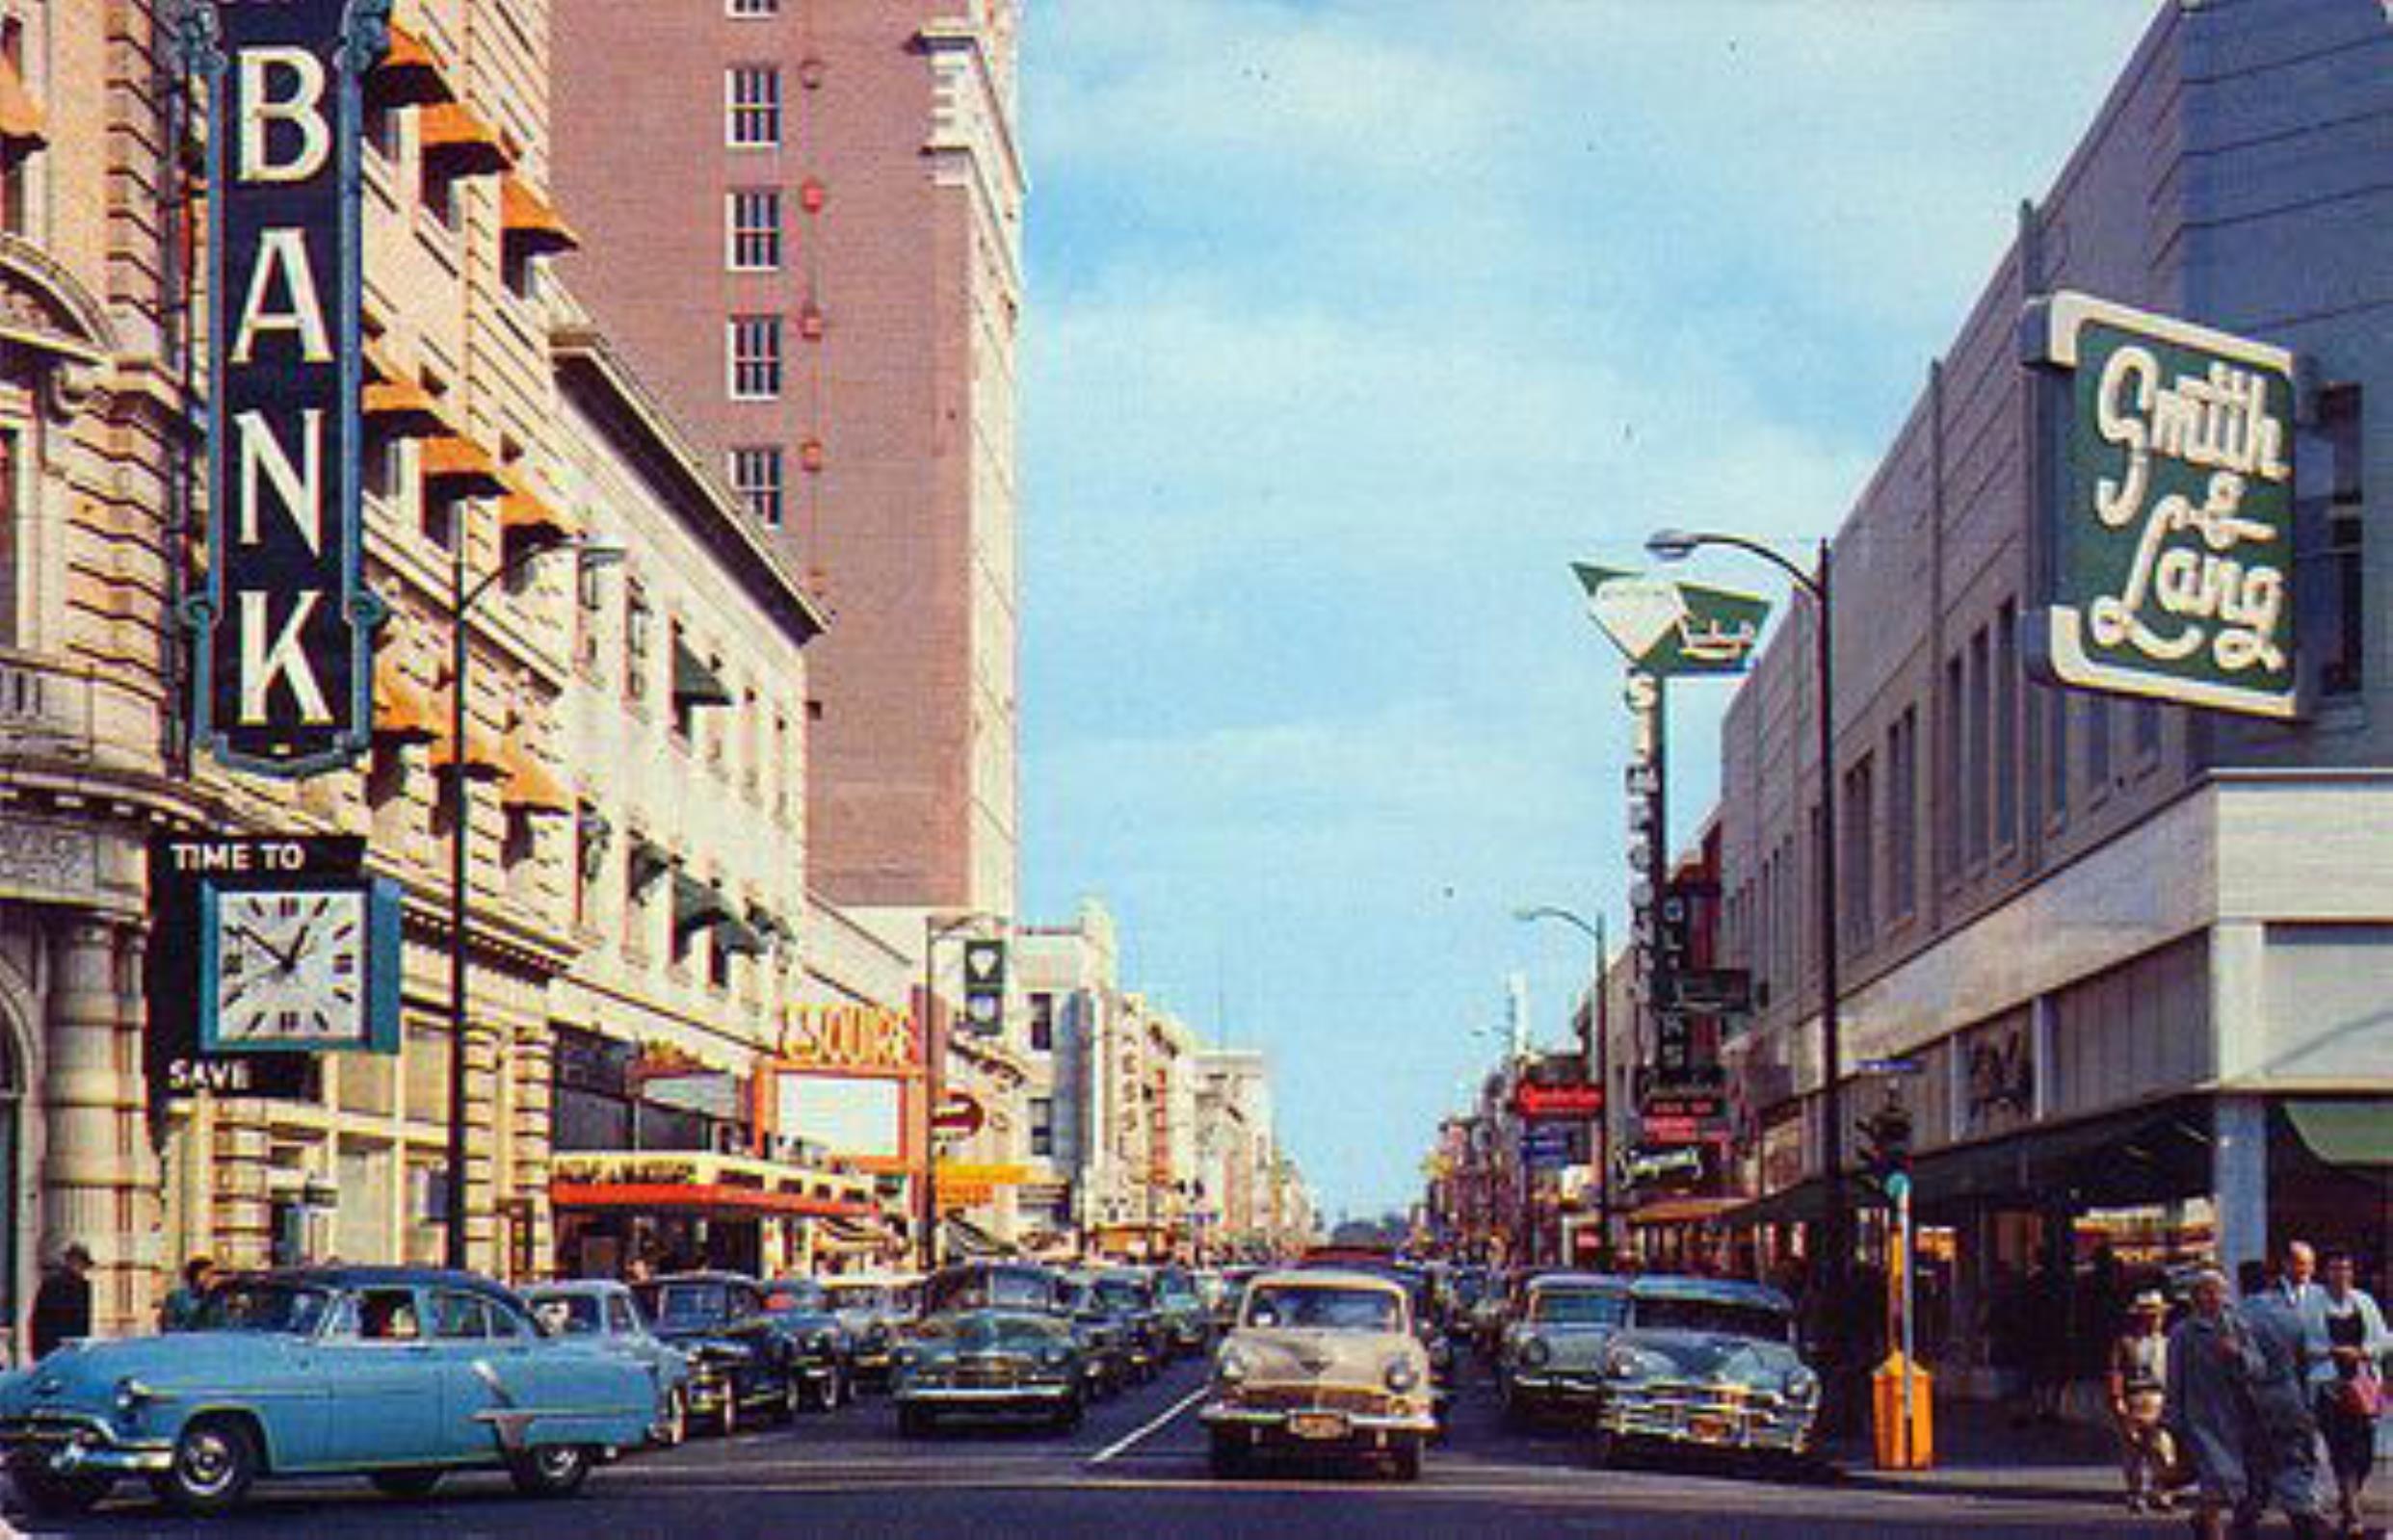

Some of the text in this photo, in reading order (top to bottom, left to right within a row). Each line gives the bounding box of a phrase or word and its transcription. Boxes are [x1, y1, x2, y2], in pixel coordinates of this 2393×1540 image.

[230, 44, 335, 725] BANK
[2094, 345, 2291, 527] Smith
[2191, 472, 2276, 549] &
[2089, 493, 2288, 672] Lang
[170, 842, 306, 871] TIME TO
[168, 1058, 250, 1091] SAVE
